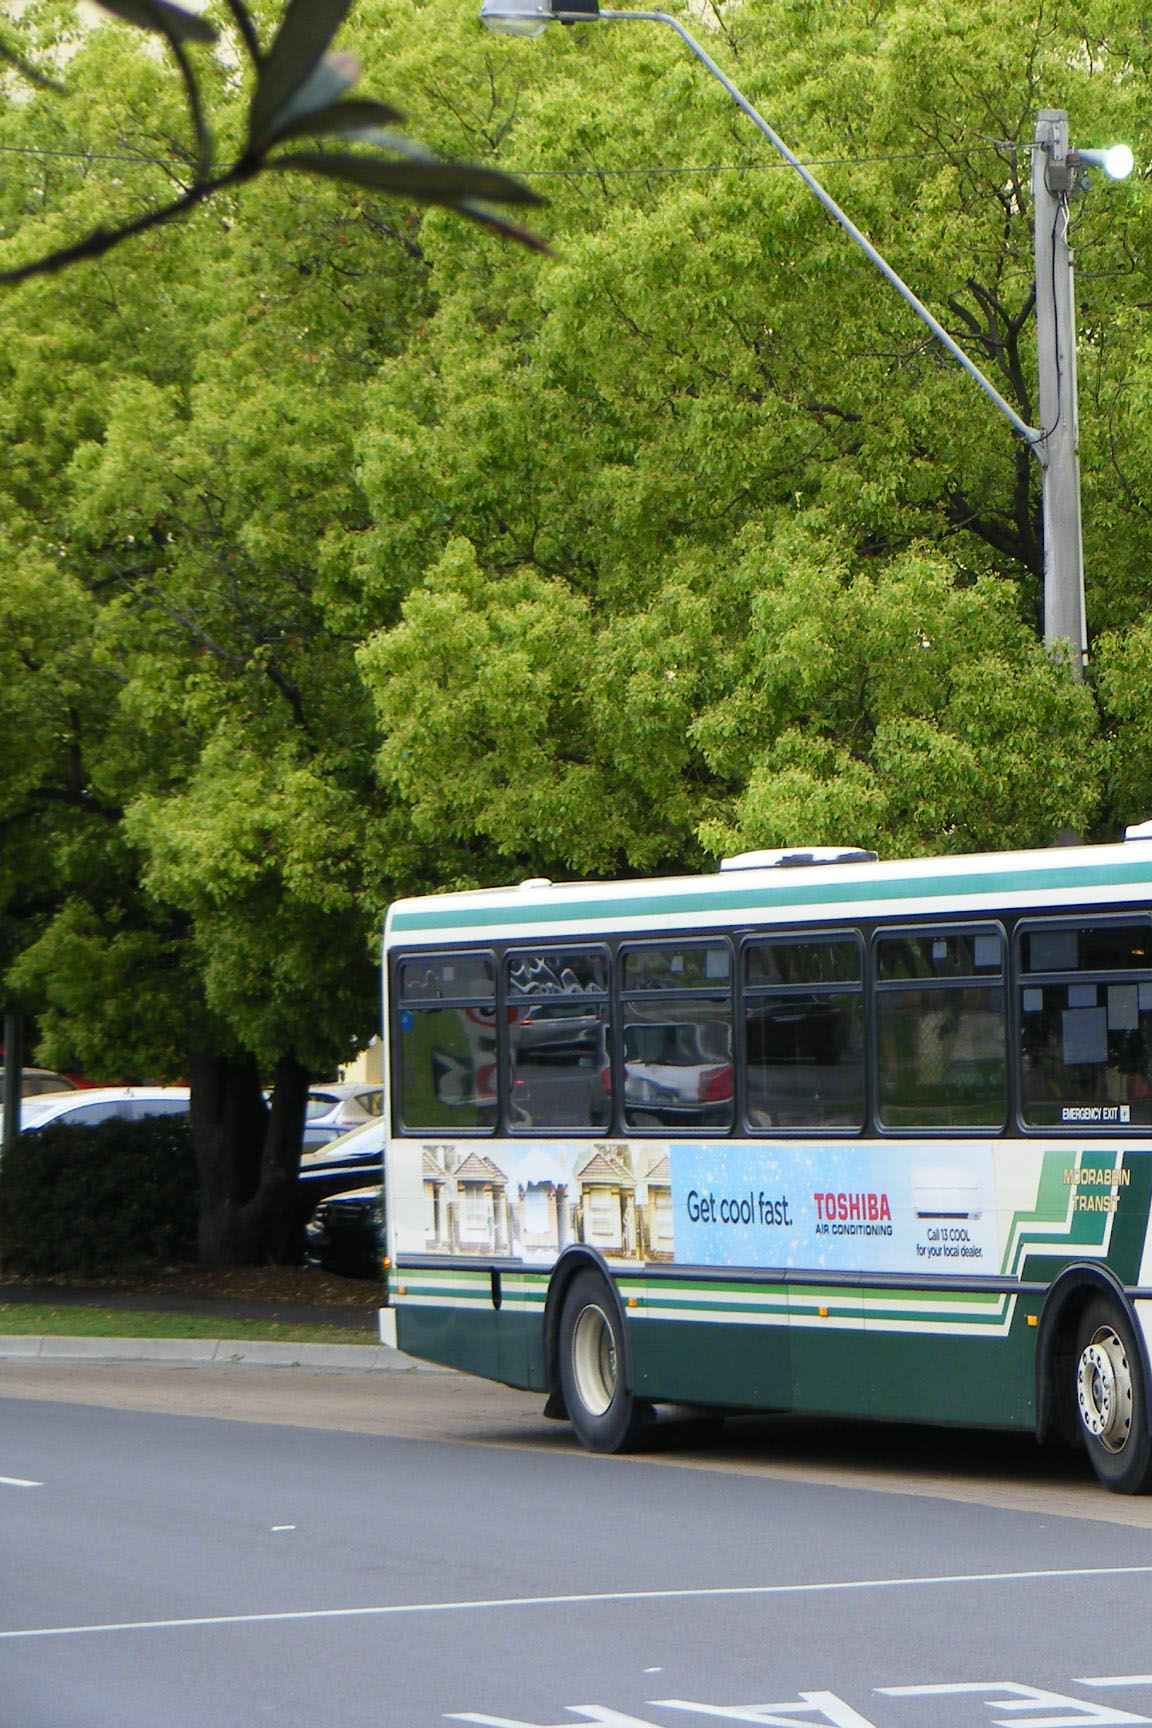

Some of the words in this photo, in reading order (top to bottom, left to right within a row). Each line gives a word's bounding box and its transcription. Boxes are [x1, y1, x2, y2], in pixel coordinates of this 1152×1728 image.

[1062, 1107, 1101, 1120] EMERGENCY
[1102, 1107, 1118, 1120] EXIT
[1063, 1168, 1131, 1186] MOORABBIN
[687, 1190, 716, 1223] Get
[720, 1191, 755, 1224] cool
[759, 1191, 793, 1227] fast.
[814, 1192, 892, 1221] TOSHIBA
[1071, 1195, 1121, 1213] TRANSIT
[815, 1224, 829, 1234] AIR
[831, 1224, 893, 1236] CONDITIONING
[927, 1228, 940, 1241] Call
[941, 1228, 948, 1241] 13
[949, 1228, 971, 1242] COOL
[916, 1243, 926, 1257] for
[927, 1245, 942, 1259] your
[943, 1244, 960, 1257] local
[960, 1244, 983, 1258] dealer.
